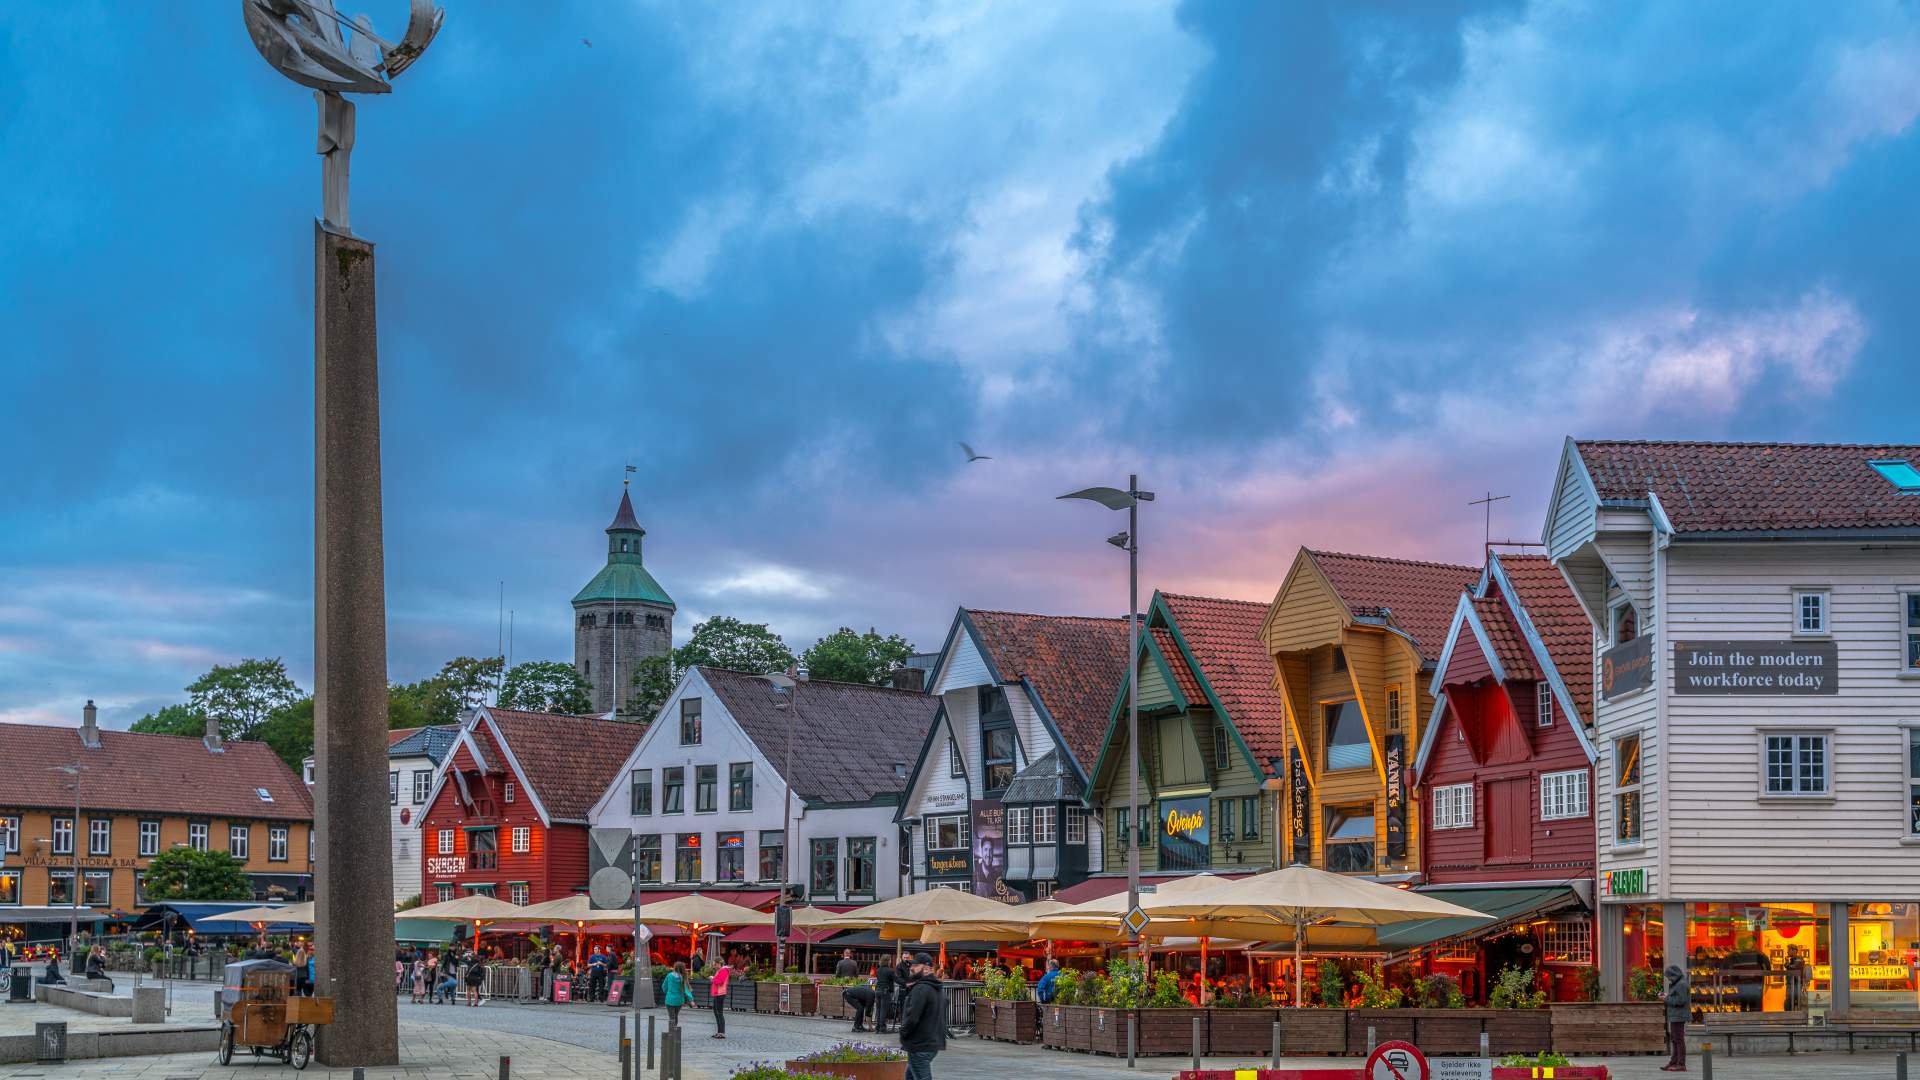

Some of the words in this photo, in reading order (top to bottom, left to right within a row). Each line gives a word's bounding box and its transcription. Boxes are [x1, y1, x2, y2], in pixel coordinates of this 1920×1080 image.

[1688, 652, 1724, 666] Join
[1729, 651, 1754, 666] the
[1759, 652, 1823, 666] modern
[1688, 672, 1773, 687] workforce
[1778, 672, 1824, 690] today
[1293, 758, 1306, 838] backstage
[1167, 809, 1204, 836] Ovenpå
[24, 857, 46, 866] VILLA
[48, 858, 58, 866] 22
[120, 859, 137, 867] BAR
[427, 857, 466, 874] SKAGEN
[1441, 1060, 1465, 1069] Gjelder
